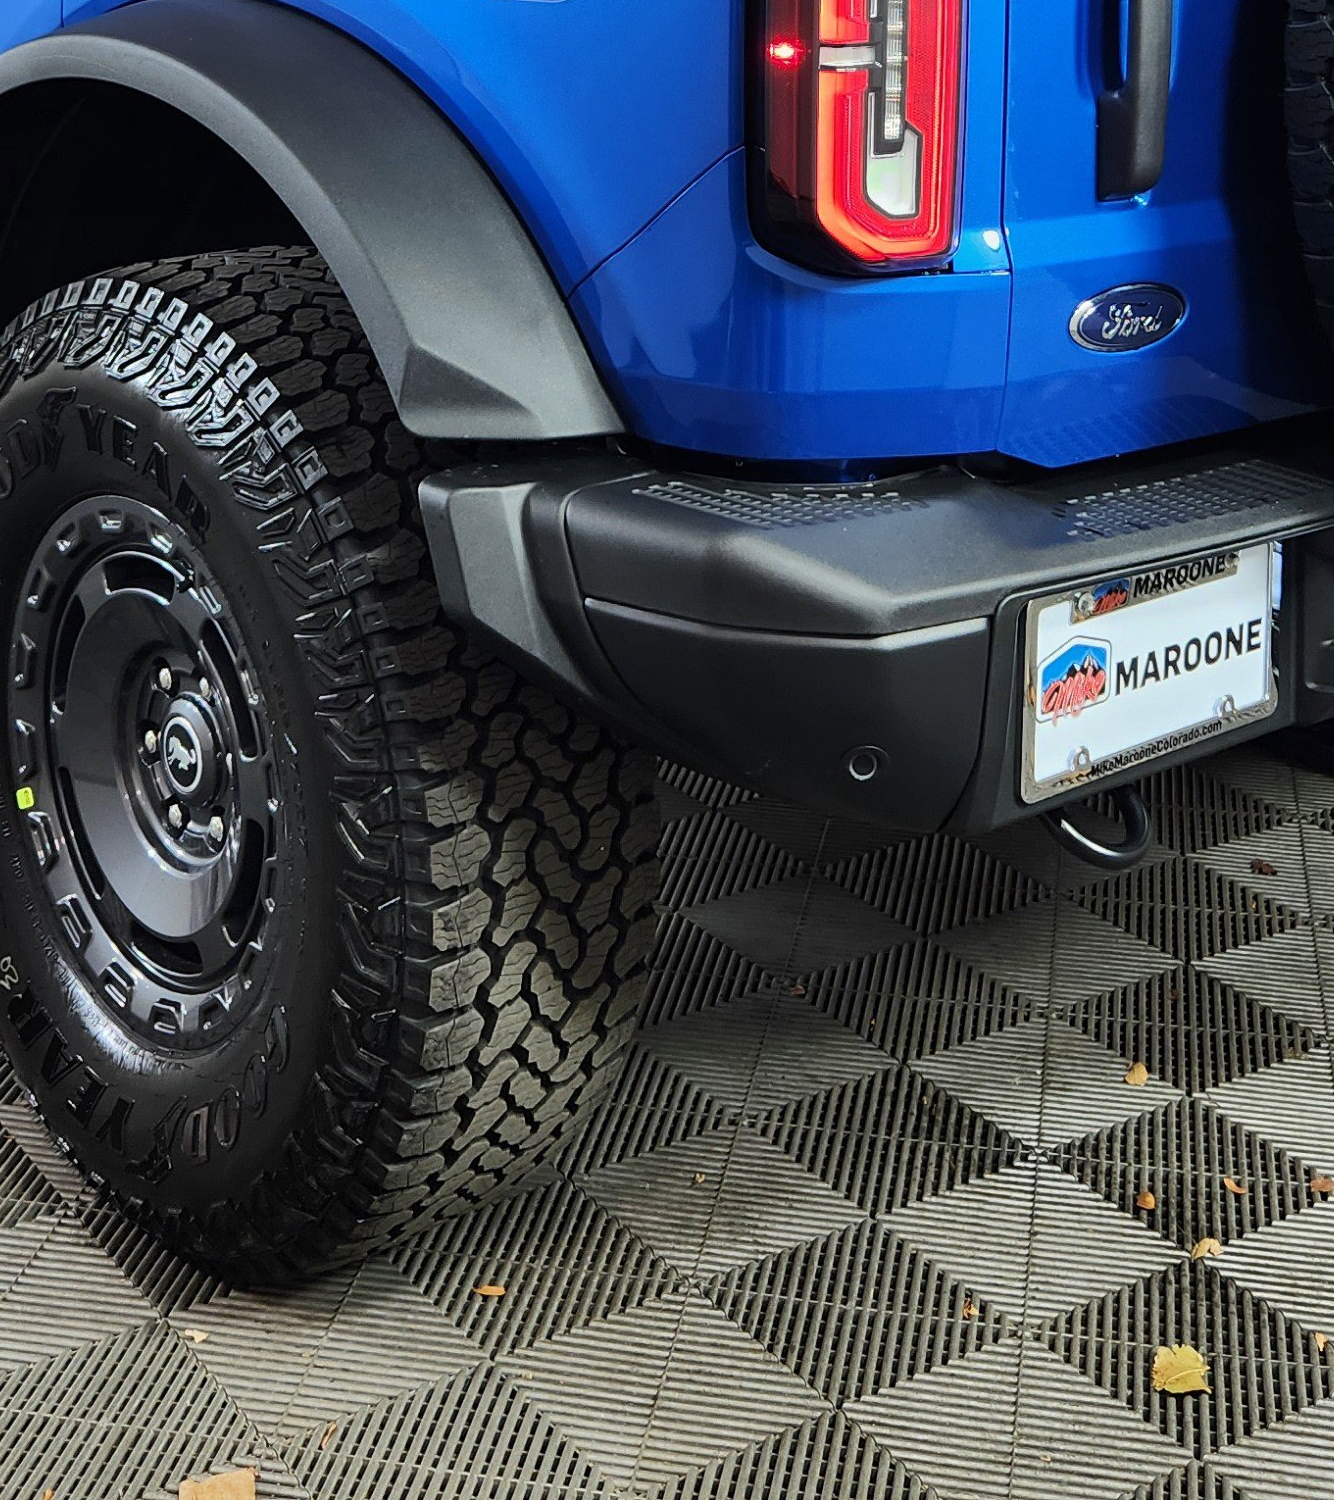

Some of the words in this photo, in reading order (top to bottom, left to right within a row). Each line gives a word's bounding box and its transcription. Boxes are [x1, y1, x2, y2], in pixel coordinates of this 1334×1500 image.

[1101, 303, 1163, 340] Ford
[1133, 554, 1226, 598] MAROONE
[1114, 617, 1263, 697] MAROONE
[1090, 719, 1223, 777] MikeMarooneColorado.com
